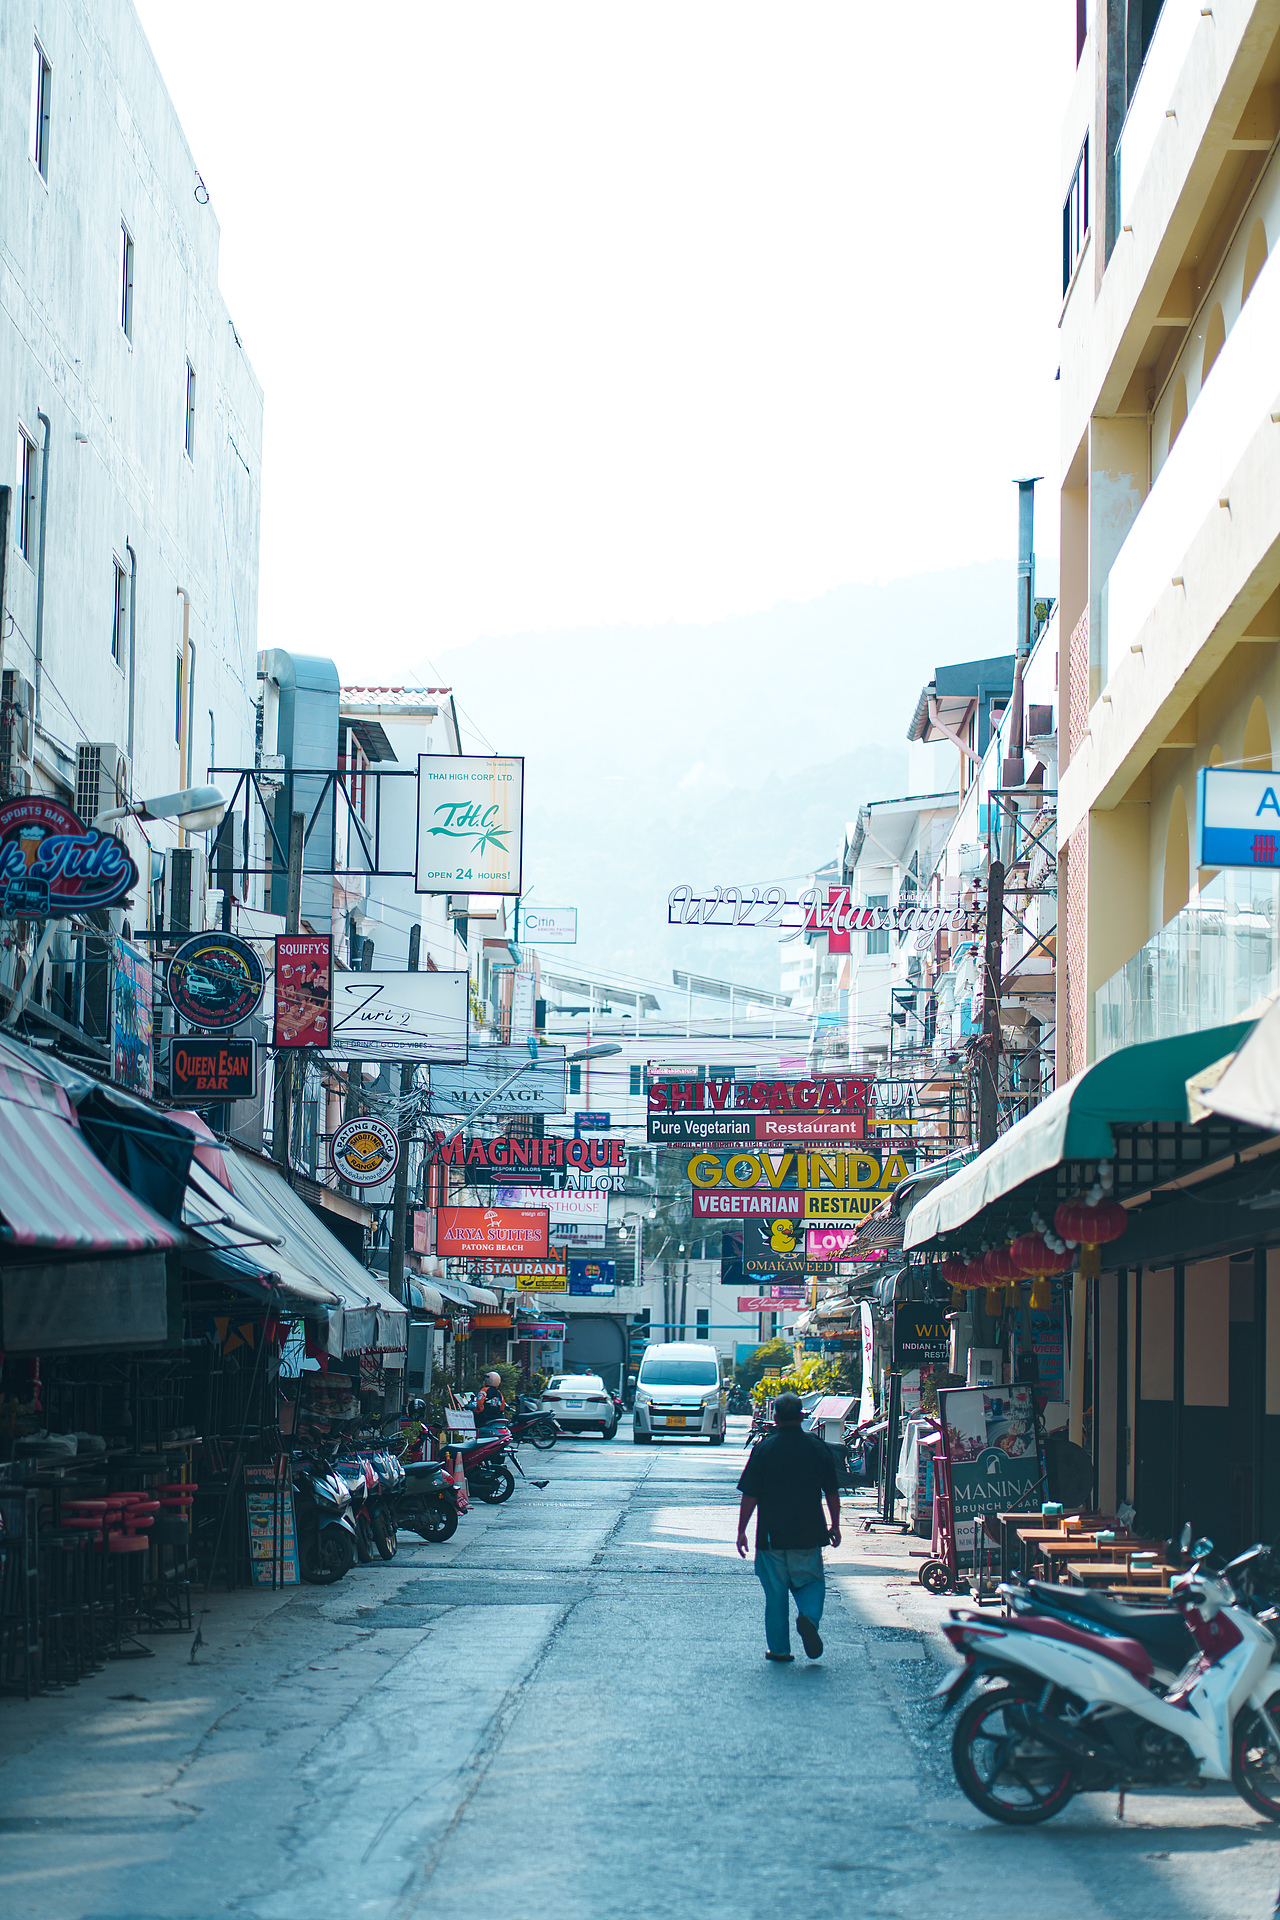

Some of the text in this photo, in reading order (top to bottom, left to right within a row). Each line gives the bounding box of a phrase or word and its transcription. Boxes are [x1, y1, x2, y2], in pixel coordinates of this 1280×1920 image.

[471, 773, 496, 781] CORP.
[1, 806, 66, 825] SPORTS BAR
[427, 868, 511, 880] OPEN 24 HOURS!
[778, 887, 970, 951] Massage
[279, 942, 329, 956] SQUIFFY'S
[334, 985, 396, 1032] Zuri
[196, 1077, 229, 1090] BAR
[652, 1120, 857, 1137] Pure Vegetarian Restaurant
[337, 1123, 394, 1152] PATONG BEACH
[350, 1134, 381, 1147] SHOOTING
[431, 1131, 627, 1172] MAGNIFIQUE
[351, 1159, 377, 1170] RANGE
[687, 1153, 911, 1190] GOVINDA
[550, 1172, 626, 1192] TAILOR
[699, 1195, 799, 1213] VEGETARIAN
[443, 1228, 484, 1241] ARYA
[487, 1228, 542, 1242] SUITES
[461, 1243, 495, 1251] PATONG
[466, 1262, 566, 1274] RESTAURANT
[746, 1260, 833, 1272] OMAKAWEED
[915, 1324, 951, 1337] WIV
[1039, 1333, 1061, 1342] TAXI
[924, 1351, 950, 1359] RESTA
[1042, 1358, 1061, 1367] CARD
[954, 1479, 1037, 1501] MANINA
[955, 1501, 1002, 1514] BRUNCH
[276, 1539, 293, 1550] CRD
